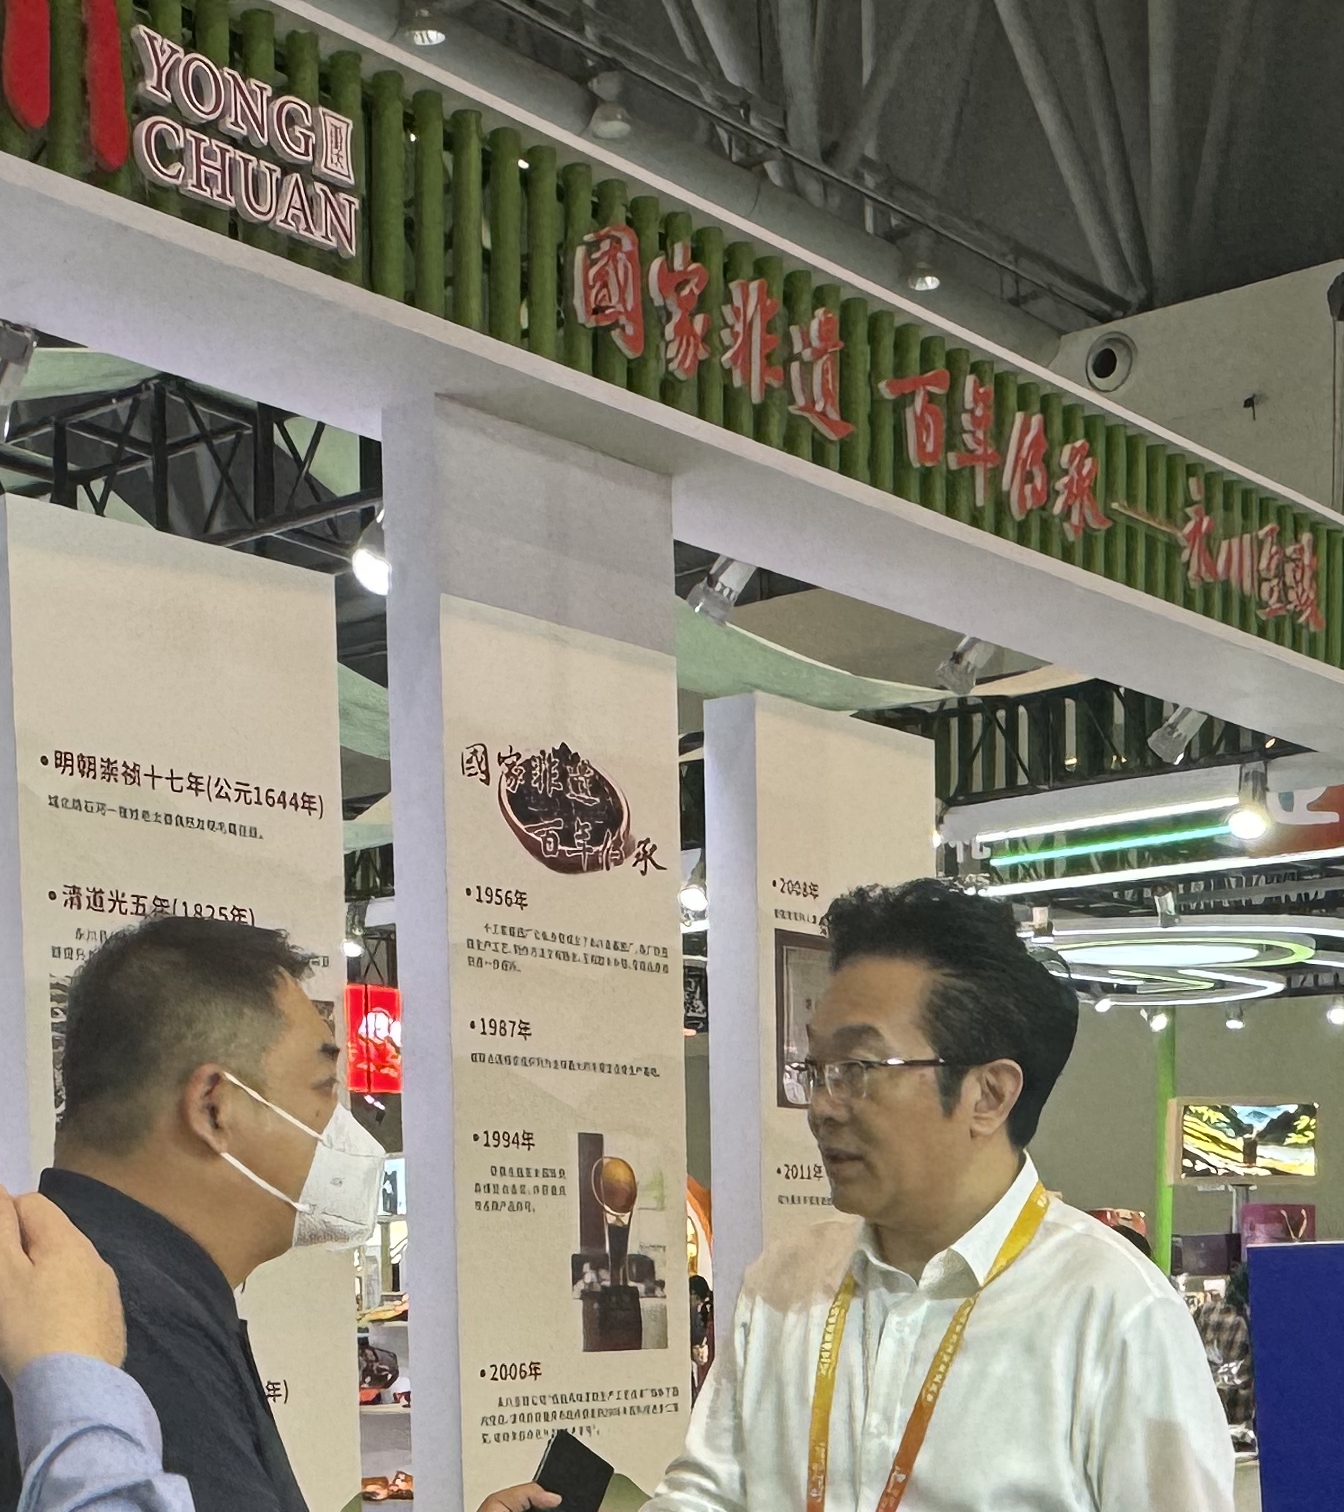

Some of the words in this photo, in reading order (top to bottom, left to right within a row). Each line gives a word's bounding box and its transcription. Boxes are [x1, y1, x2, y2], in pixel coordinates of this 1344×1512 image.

[131, 23, 317, 166] YONG
[133, 115, 360, 259] CHUAN
[475, 885, 529, 910] 1956年
[480, 1017, 533, 1041] 1987年
[482, 1129, 536, 1151] 1994年
[489, 1360, 543, 1382] 2006年
